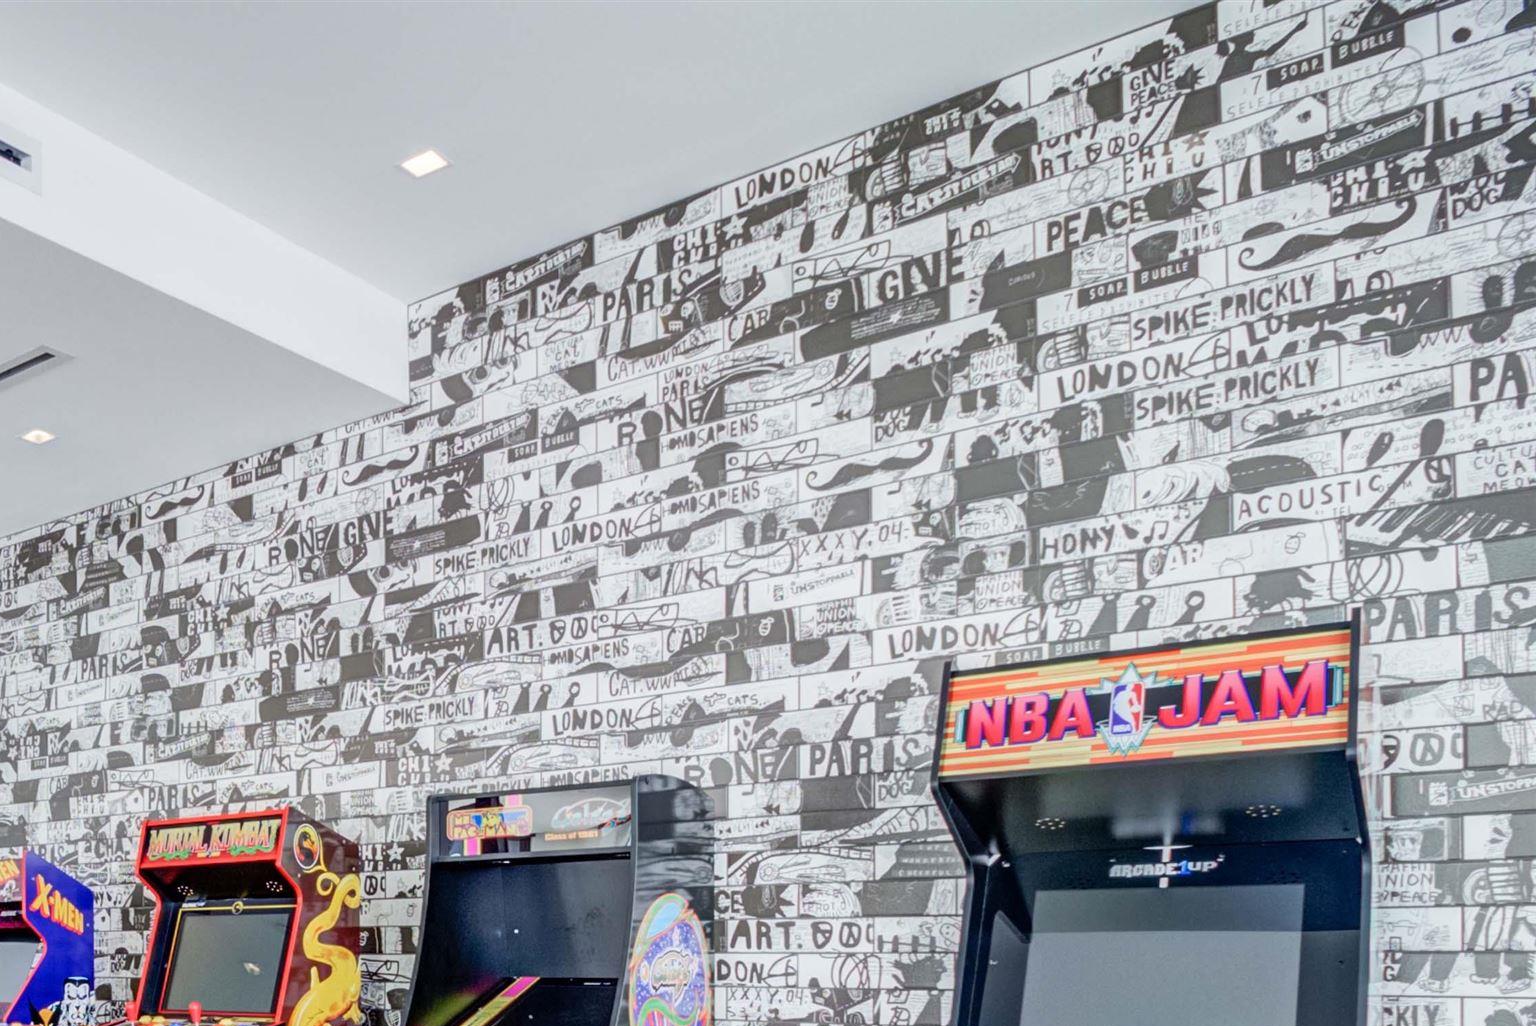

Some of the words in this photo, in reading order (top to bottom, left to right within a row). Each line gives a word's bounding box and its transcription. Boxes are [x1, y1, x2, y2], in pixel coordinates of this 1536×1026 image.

[734, 156, 831, 209] LONDON
[1046, 197, 1151, 253] PEACE
[602, 266, 694, 316] PARIS
[877, 247, 965, 305] GIVE
[1221, 272, 1316, 322] PRICKLY
[1056, 352, 1184, 403] LONDON
[1224, 357, 1320, 402] PRICKLY
[1238, 473, 1383, 521] ACOUSTIC
[552, 516, 634, 552] LONDON
[888, 621, 1001, 660] LONDON
[1365, 585, 1530, 646] PARIS
[552, 707, 635, 737] LONDON
[965, 686, 1097, 750] NBA
[1156, 659, 1329, 730] JAM
[810, 736, 920, 780] PARIS
[147, 825, 209, 858] MORTAL
[208, 818, 282, 853] KOMBAT
[28, 874, 85, 936] X-MEN
